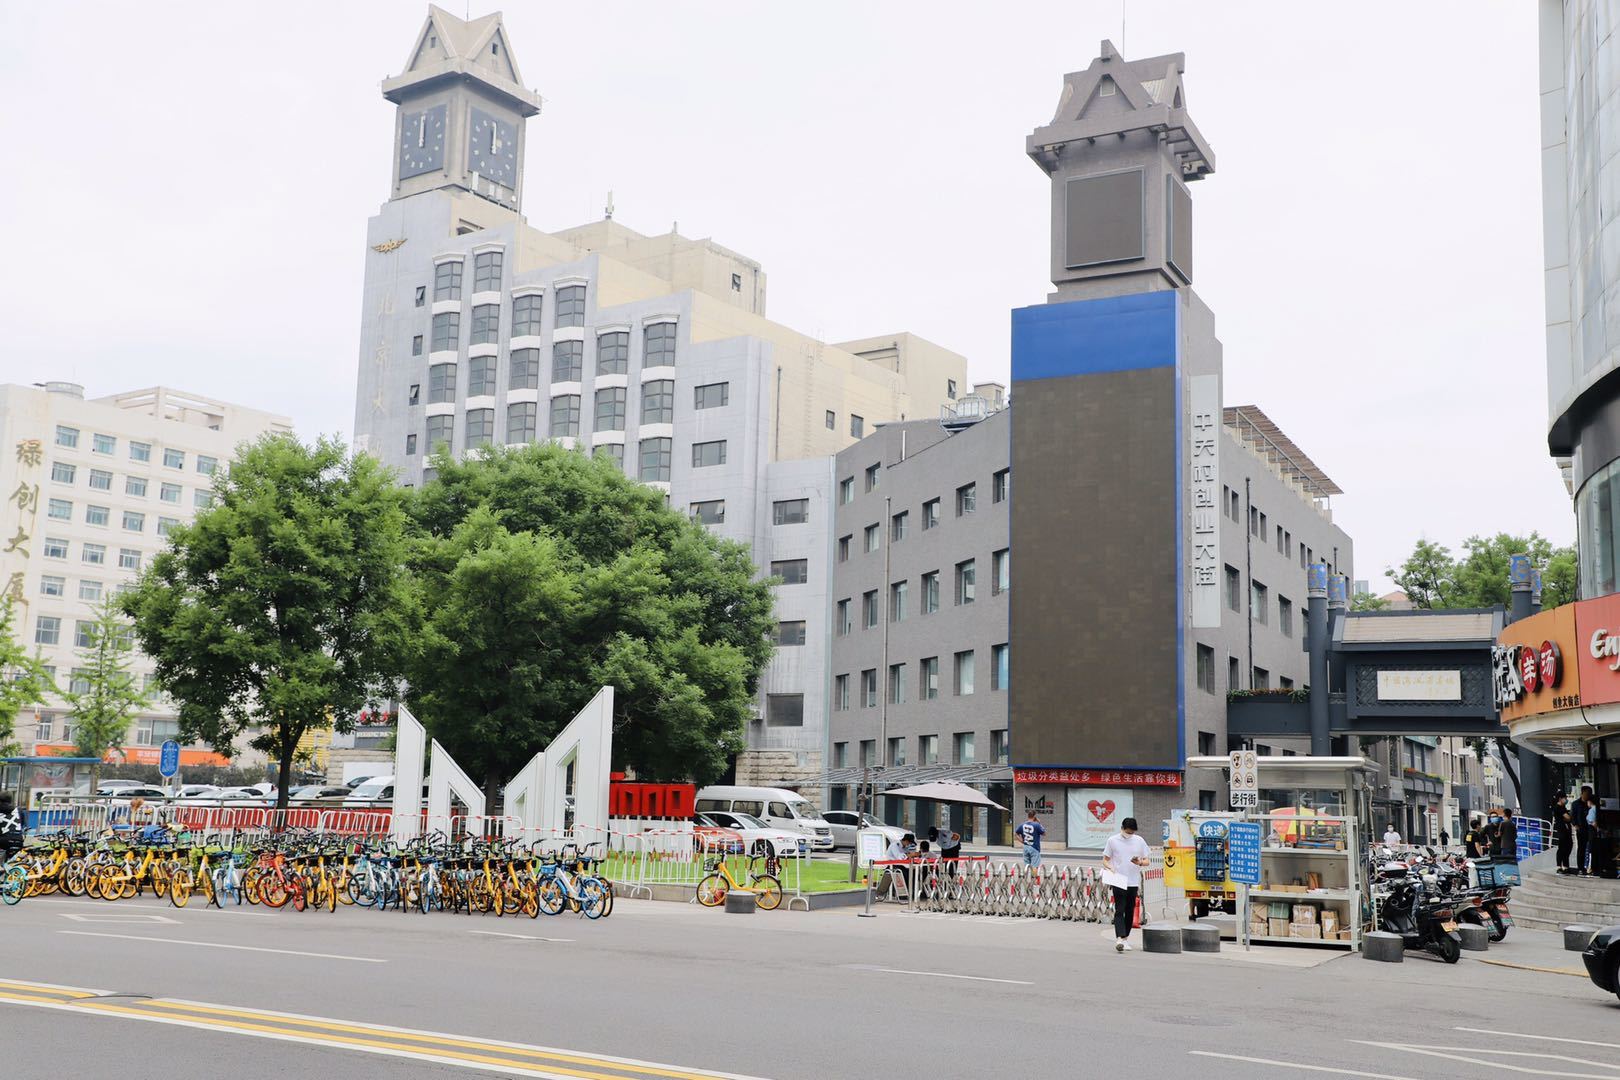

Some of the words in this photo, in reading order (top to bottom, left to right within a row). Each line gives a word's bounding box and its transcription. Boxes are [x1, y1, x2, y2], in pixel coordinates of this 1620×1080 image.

[1017, 771, 1091, 782] 垃圾分类益处多
[1100, 772, 1177, 784] 绿色生活靠你我
[1231, 792, 1257, 806] 步行街
